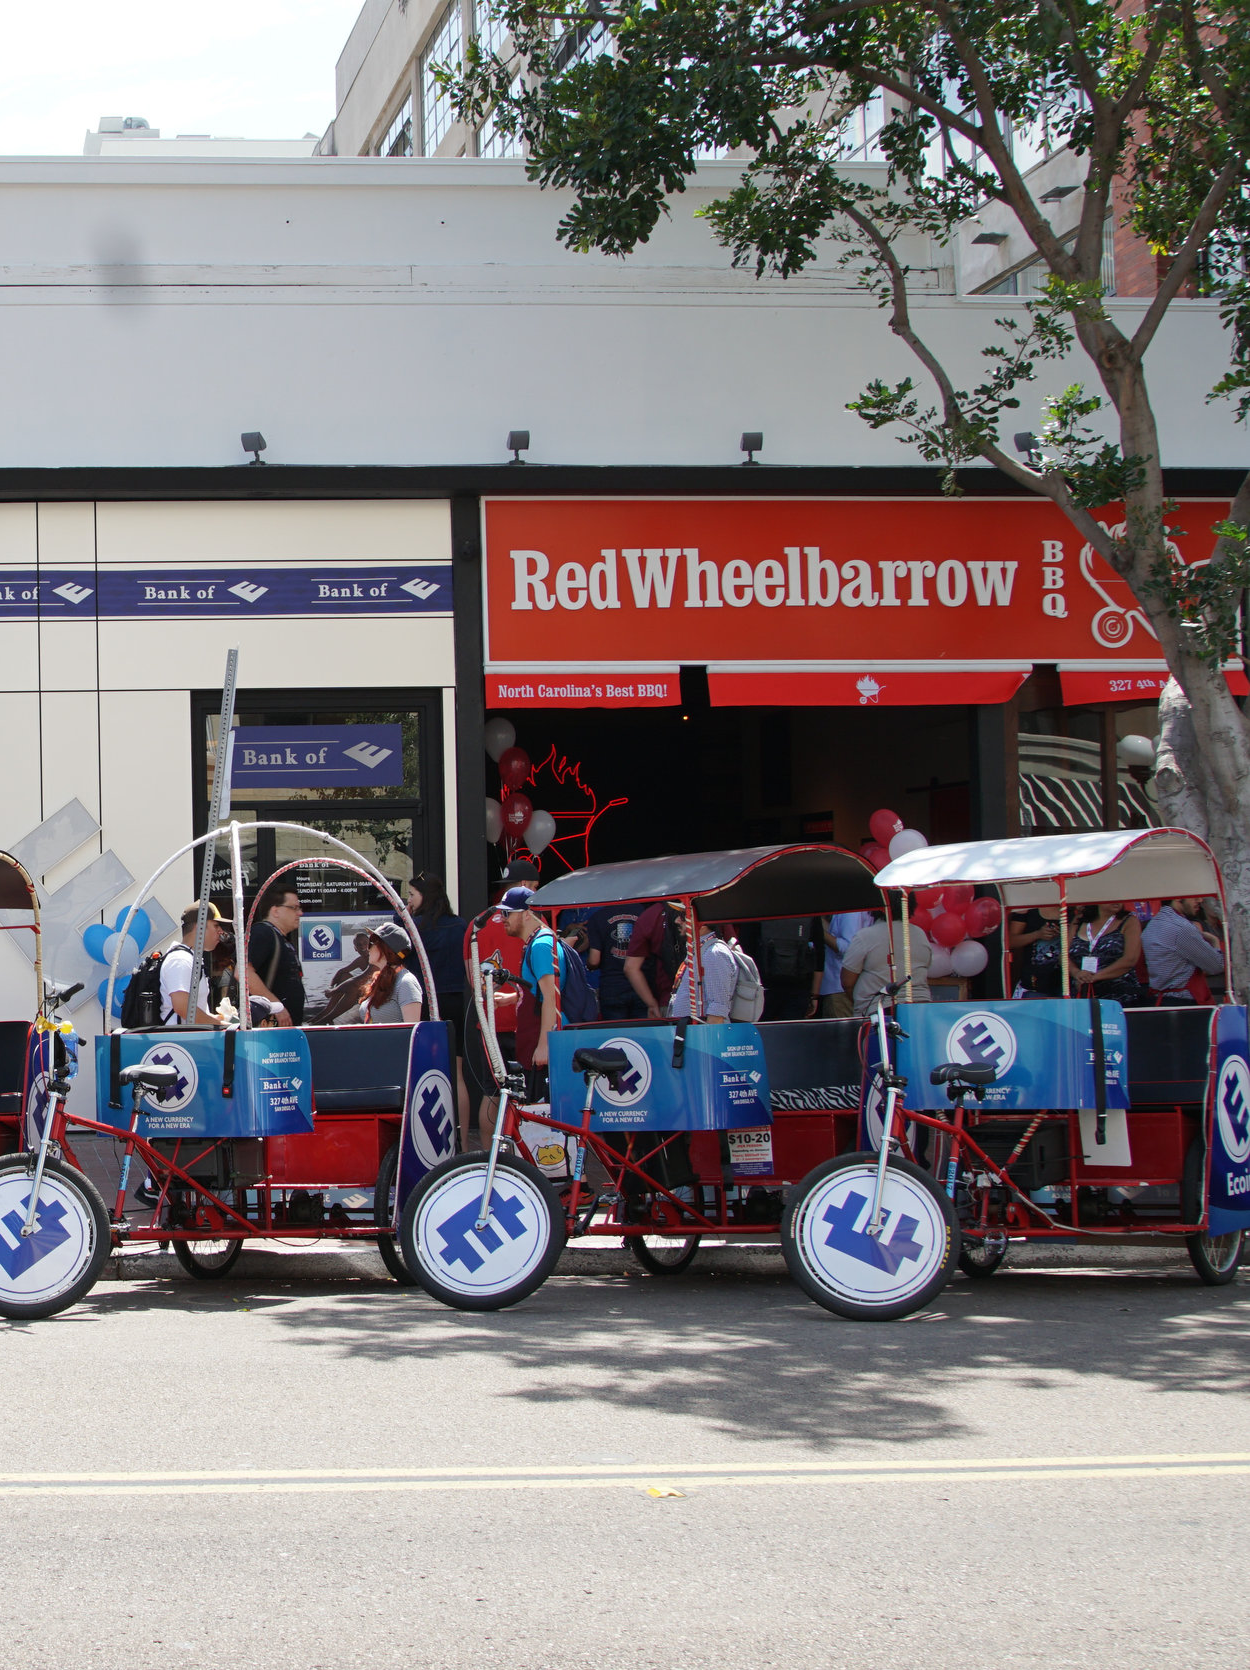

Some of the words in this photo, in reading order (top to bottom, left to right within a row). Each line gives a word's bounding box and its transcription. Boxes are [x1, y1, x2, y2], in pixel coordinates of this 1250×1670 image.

[21, 586, 40, 600] of
[144, 585, 191, 599] Bank
[196, 585, 216, 599] of
[318, 583, 364, 597] Bank
[369, 582, 388, 597] of
[498, 684, 534, 698] North
[538, 684, 602, 697] Carolina's
[606, 684, 634, 697] Best
[638, 684, 668, 699] BBQ!
[1109, 679, 1132, 692] 327
[1136, 679, 1156, 689] 4th
[242, 748, 298, 766] Bank
[305, 747, 328, 764] of
[312, 951, 332, 959] Ecoin
[722, 1074, 740, 1083] Bank
[740, 1073, 747, 1082] of
[263, 1080, 282, 1090] Bank
[282, 1080, 289, 1089] of
[728, 1090, 739, 1099] 327
[739, 1090, 747, 1098] 4th
[747, 1089, 758, 1097] AVE
[270, 1097, 281, 1106] 327
[728, 1133, 770, 1145] $10-20
